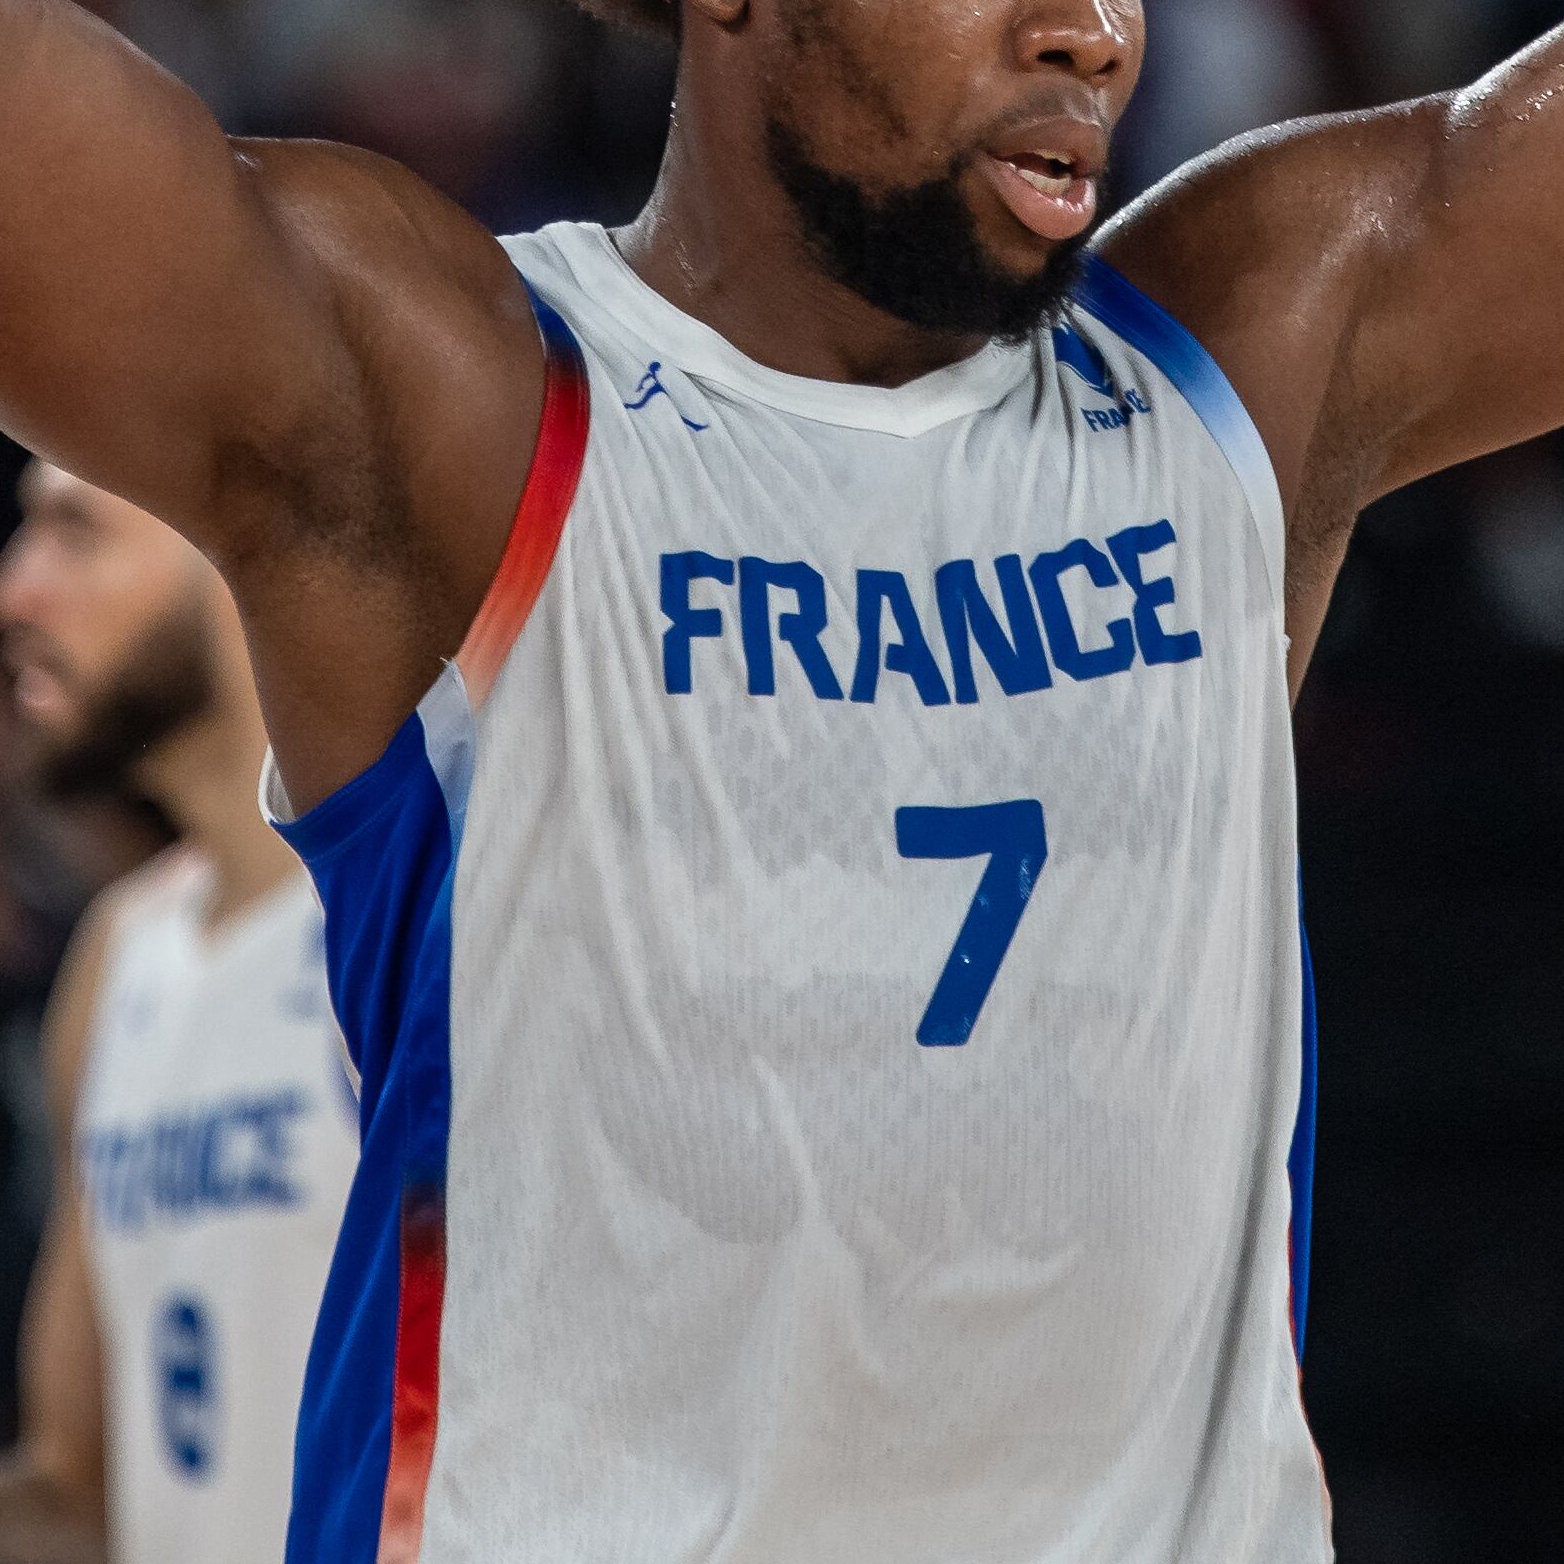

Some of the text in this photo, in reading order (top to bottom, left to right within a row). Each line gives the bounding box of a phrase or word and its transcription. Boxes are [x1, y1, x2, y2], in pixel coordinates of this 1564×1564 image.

[1080, 388, 1152, 433] FRACE
[659, 519, 1202, 706] FRANCE
[894, 798, 1048, 1047] 7
